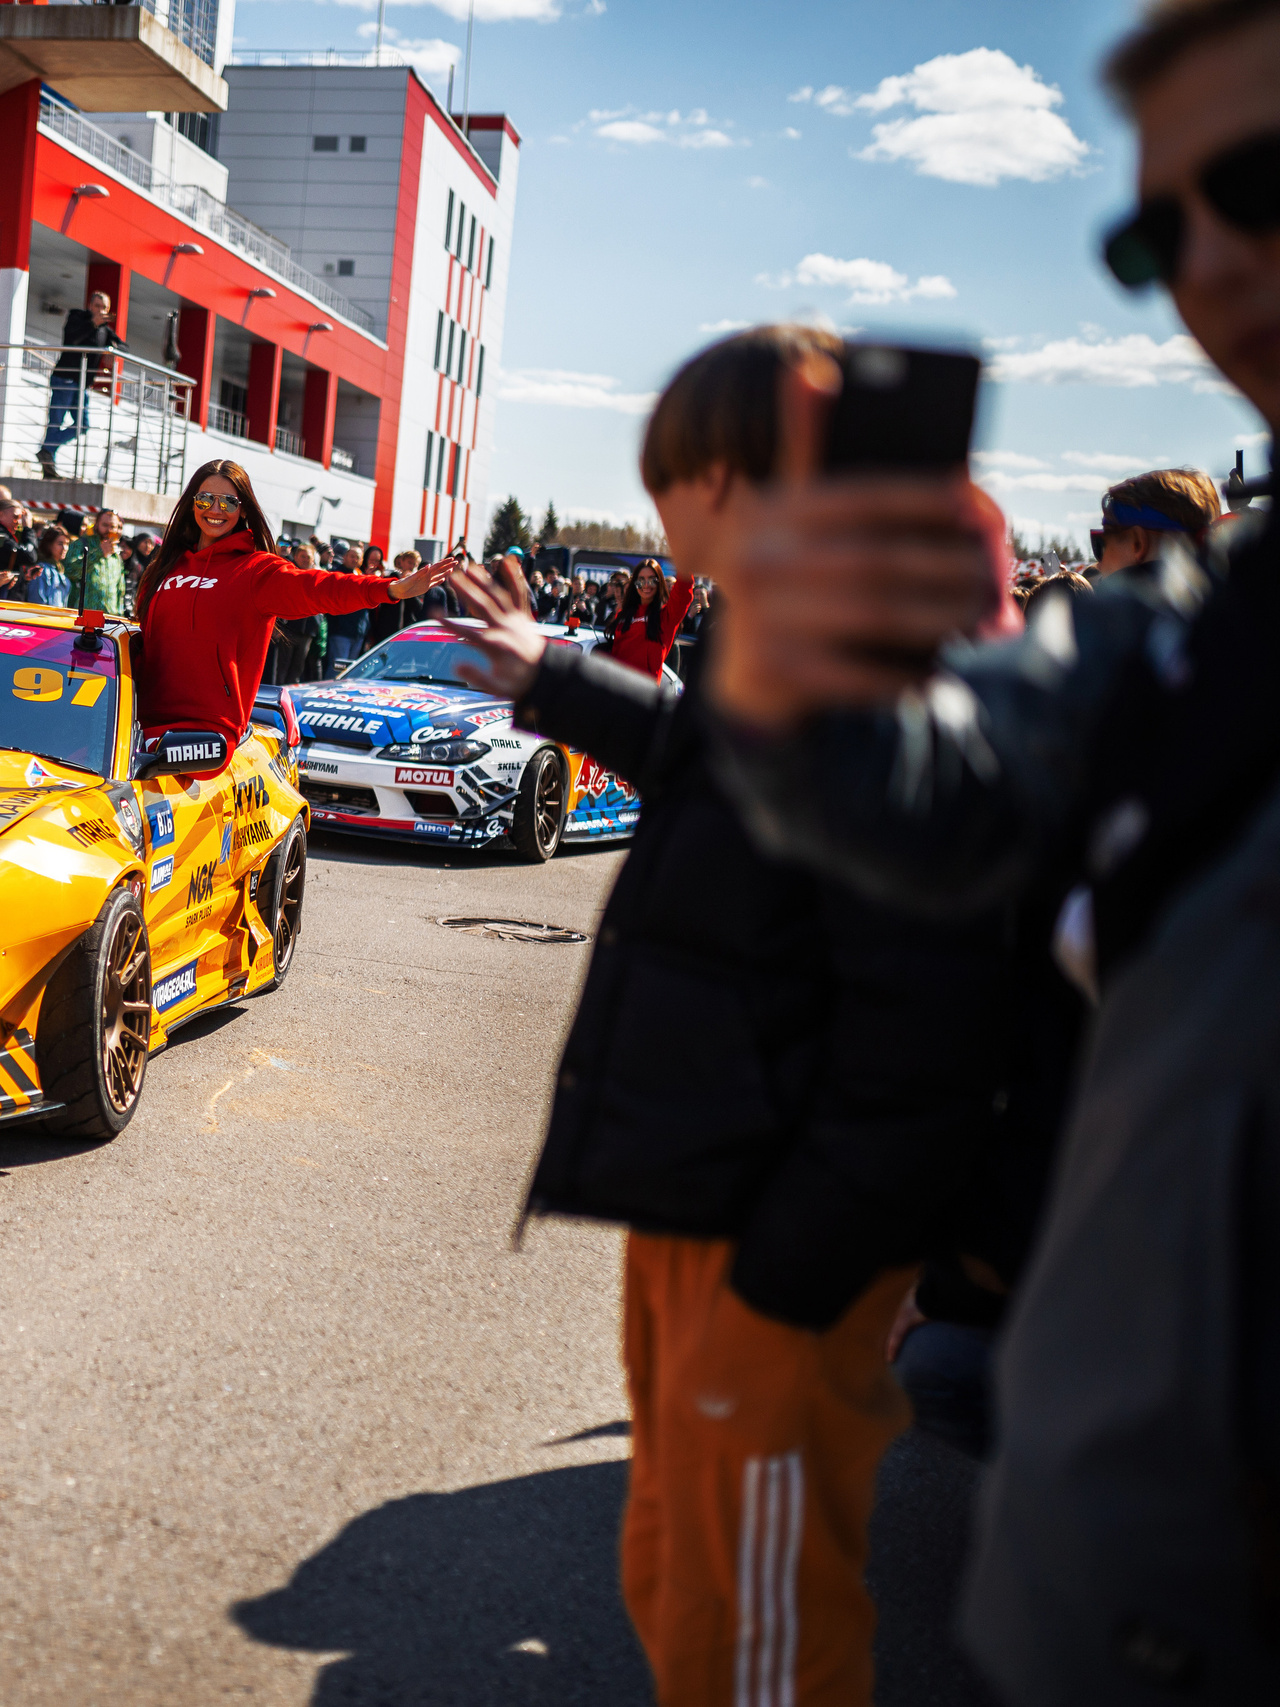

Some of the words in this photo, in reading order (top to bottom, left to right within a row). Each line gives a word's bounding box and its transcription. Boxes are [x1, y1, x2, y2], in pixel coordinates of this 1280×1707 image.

[11, 667, 107, 708] 97
[297, 711, 384, 735] MAHLE
[167, 742, 221, 763] MAHLE
[490, 738, 522, 749] MAHLE
[398, 770, 451, 785] MOTUL
[497, 762, 522, 771] SKILL
[66, 818, 117, 848] MAHLE
[415, 824, 448, 833] AIMOL
[186, 858, 218, 910] NGK
[152, 968, 197, 1009] VIRAGE24.RU
